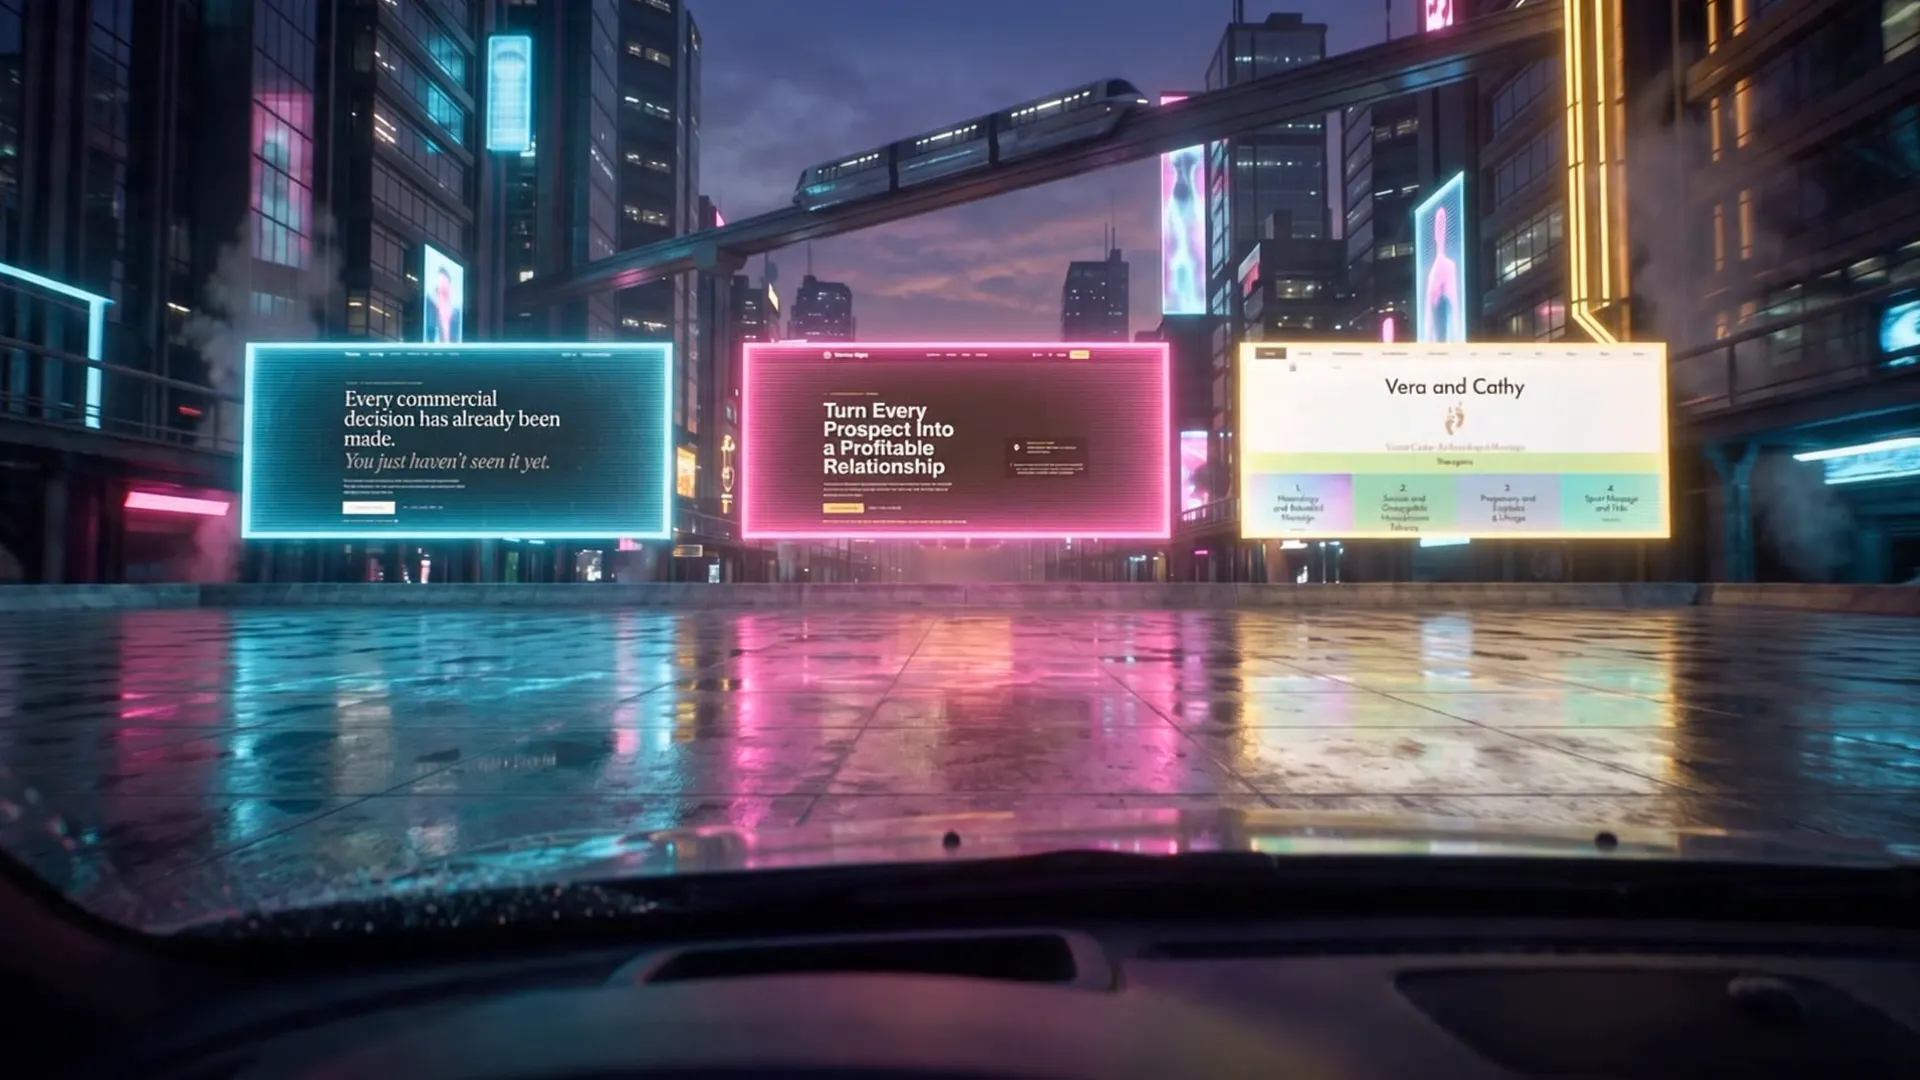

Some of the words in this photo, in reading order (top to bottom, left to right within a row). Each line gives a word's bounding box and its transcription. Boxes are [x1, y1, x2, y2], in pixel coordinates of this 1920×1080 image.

[1385, 378, 1427, 395] Vera
[1432, 377, 1467, 395] and
[1472, 377, 1525, 400] Cathy
[345, 390, 393, 411] Every
[397, 389, 497, 407] commercial
[344, 410, 415, 427] decision
[420, 410, 449, 427] has
[452, 410, 516, 431] already
[518, 410, 561, 427] been
[823, 402, 867, 419] Turn
[872, 402, 927, 423] Every
[344, 430, 396, 447] made.
[823, 421, 912, 441] Prospect
[916, 421, 954, 438] Into
[823, 443, 835, 456] a
[840, 439, 935, 456] Profitable
[345, 452, 374, 469] You
[374, 453, 407, 474] just
[410, 452, 467, 470] haven't
[470, 457, 505, 469] seen
[508, 452, 520, 469] it
[519, 455, 550, 474] yet.
[823, 458, 946, 479] Relationship
